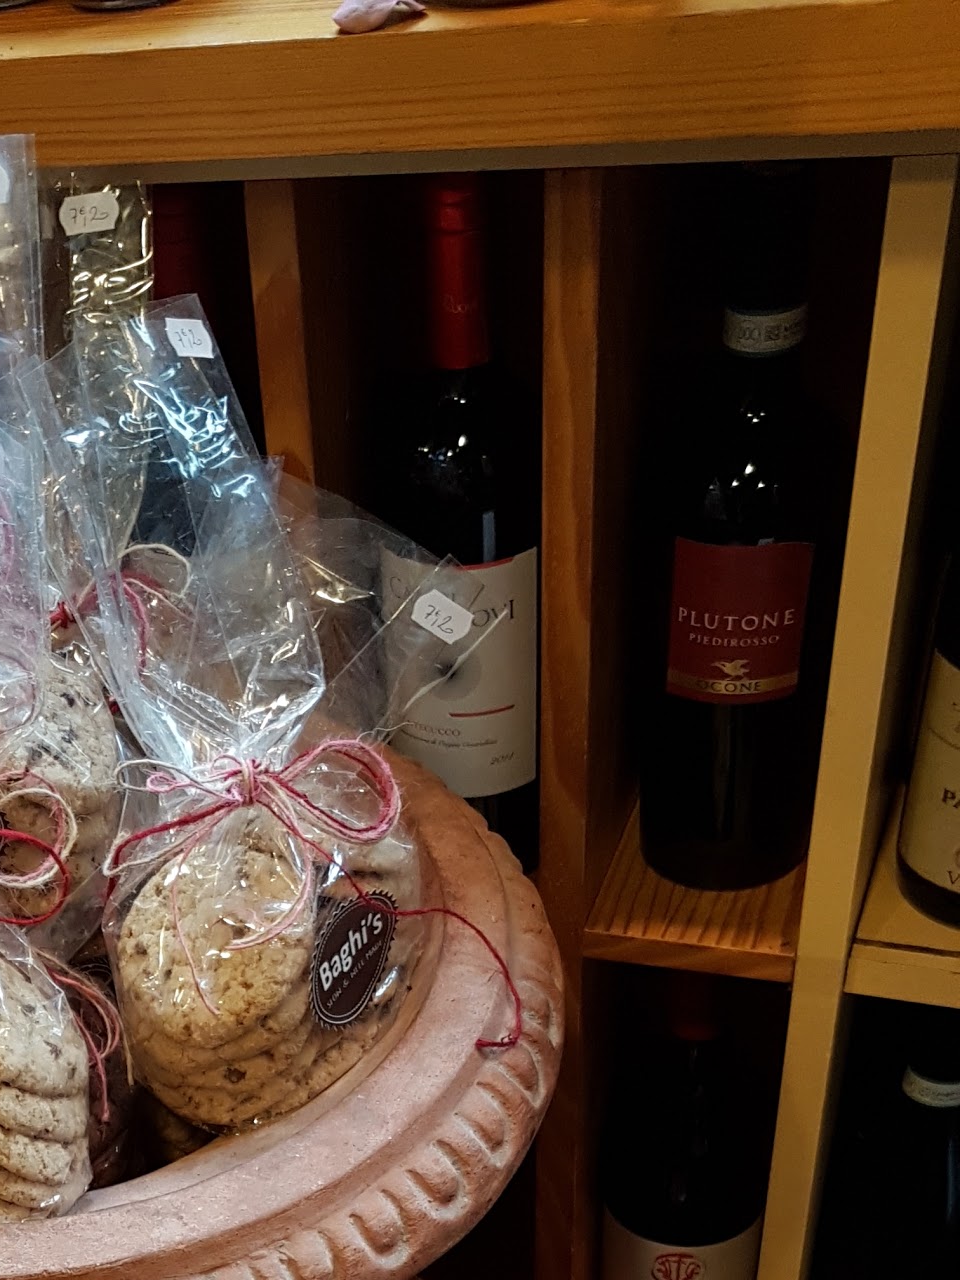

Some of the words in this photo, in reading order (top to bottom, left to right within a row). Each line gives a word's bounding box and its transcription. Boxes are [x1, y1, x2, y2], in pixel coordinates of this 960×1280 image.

[677, 606, 796, 631] PLUTONE
[689, 632, 780, 647] PIEDIROSSO
[695, 679, 763, 693] OCONE
[319, 912, 383, 992] Baghi's
